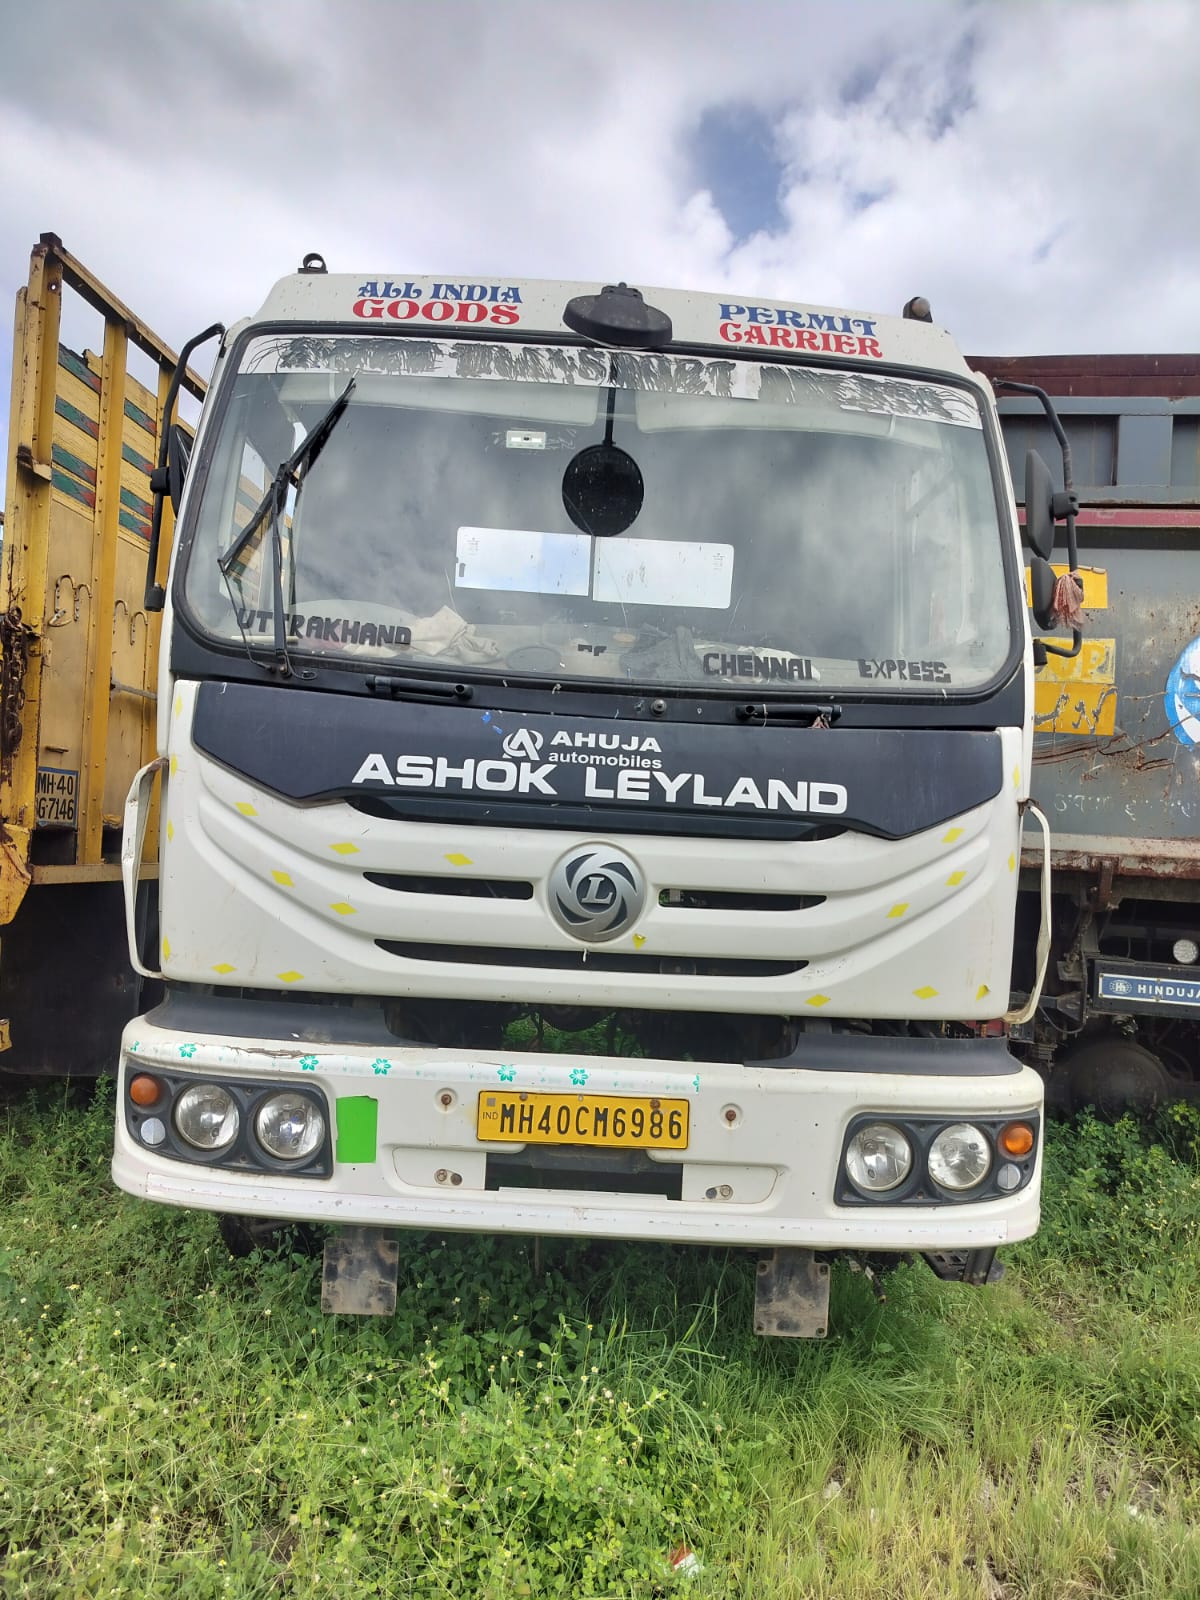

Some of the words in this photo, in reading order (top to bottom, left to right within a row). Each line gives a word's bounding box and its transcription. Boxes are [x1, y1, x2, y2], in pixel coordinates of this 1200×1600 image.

[358, 281, 423, 299] ALL
[432, 283, 523, 304] INDIA
[353, 299, 520, 325] GOODS
[719, 303, 877, 337] PERMIT
[719, 322, 883, 358] CARRIER
[702, 652, 813, 681] CHENNAI
[858, 658, 952, 684] EXPRESS
[550, 730, 663, 753] AHUJA
[548, 751, 663, 769] automobiles
[351, 753, 558, 796] ASHOK
[585, 767, 848, 815] LEYLAND
[482, 1111, 499, 1121] IND
[500, 1104, 682, 1139] MH40CM6986
